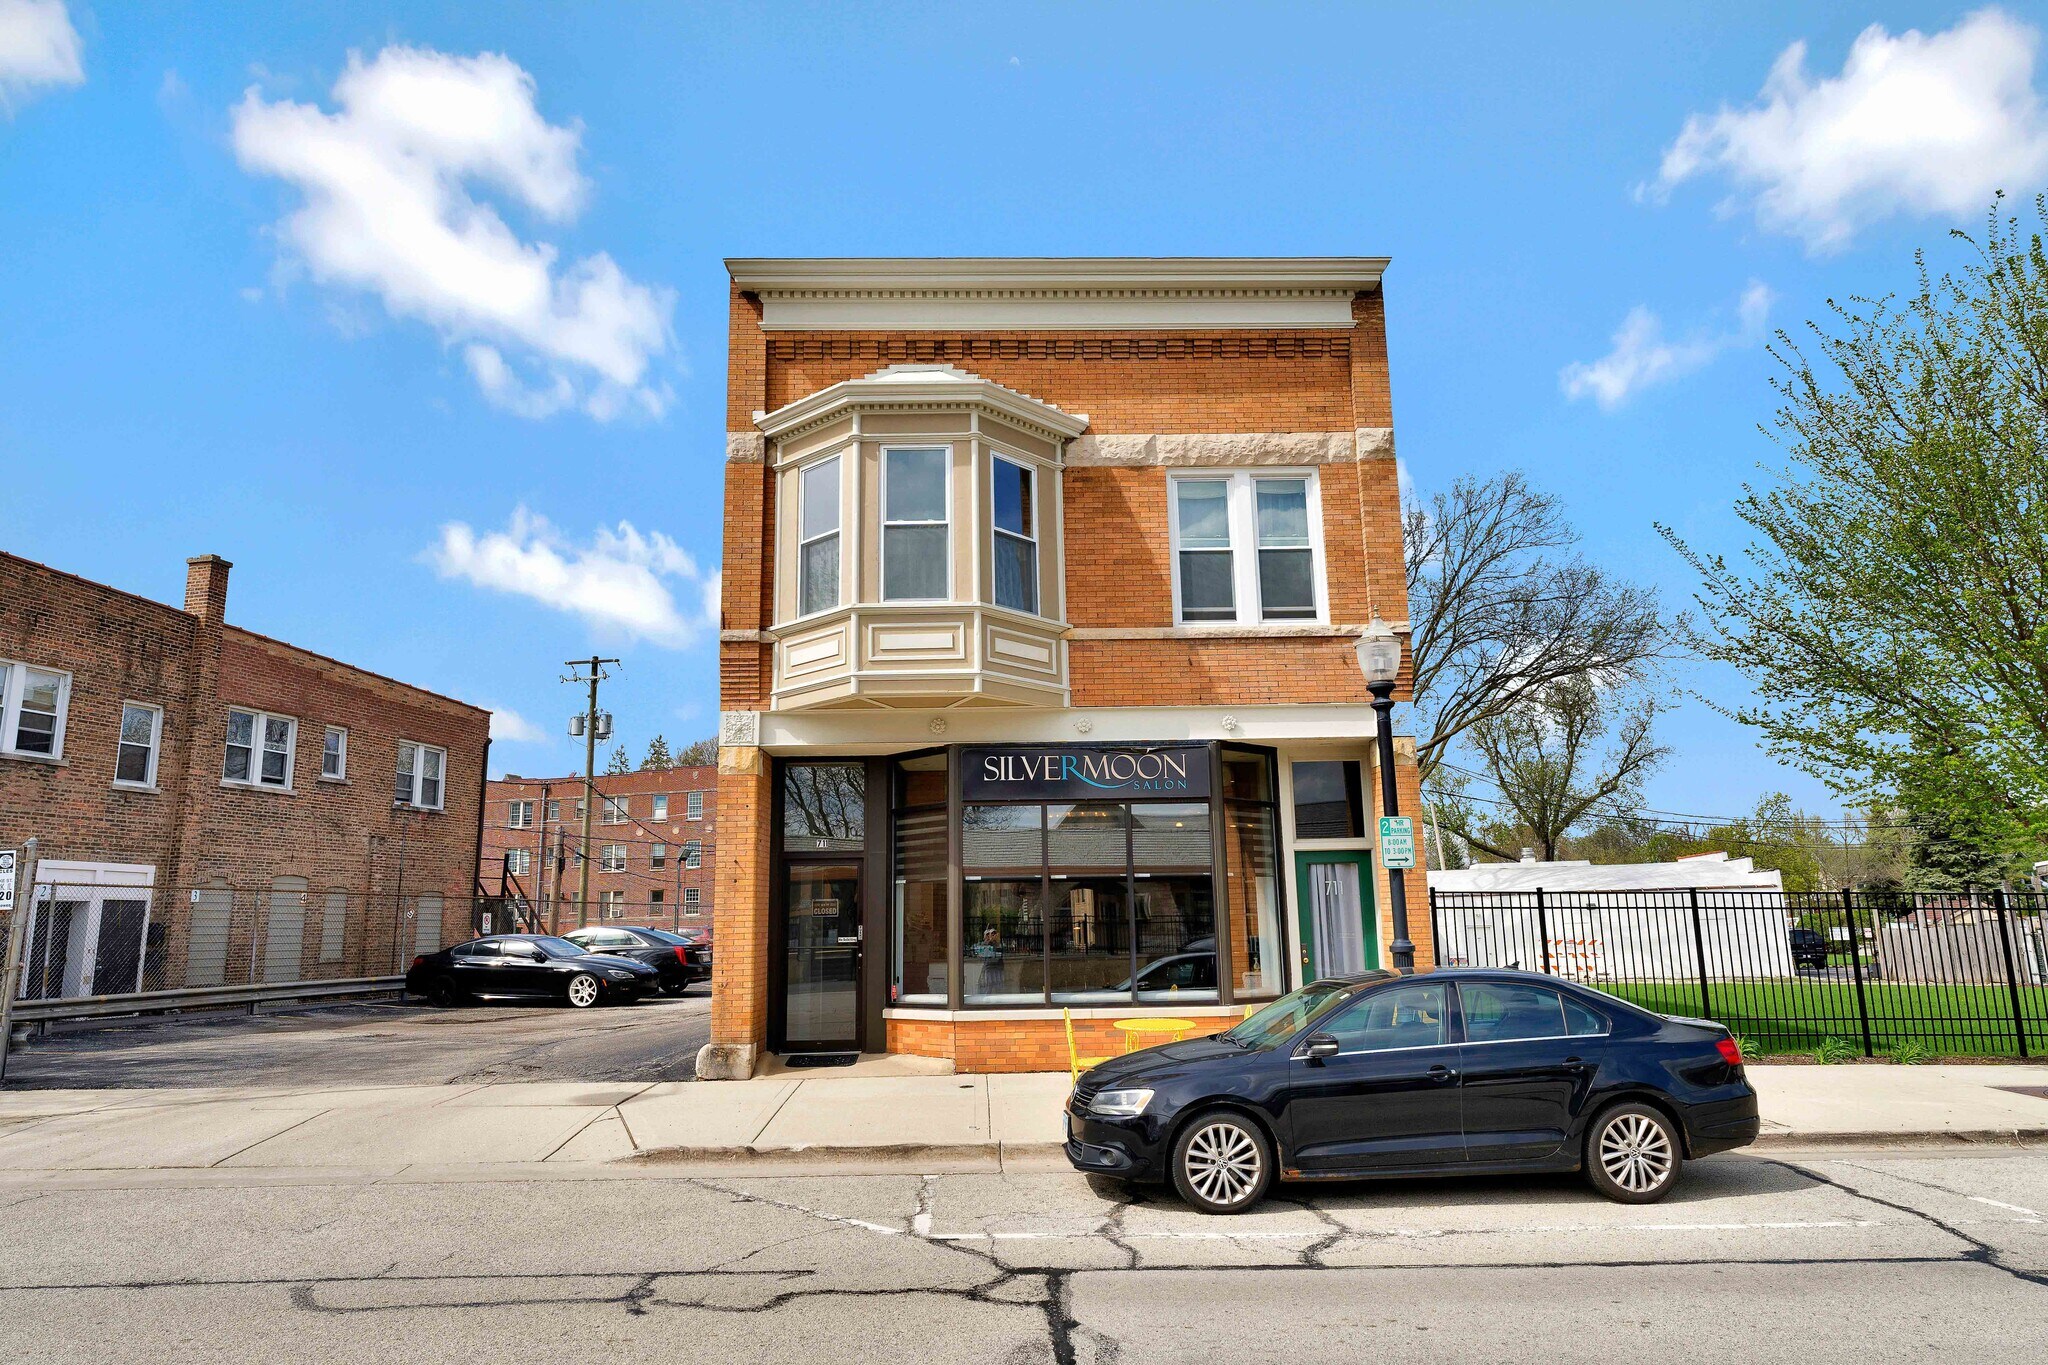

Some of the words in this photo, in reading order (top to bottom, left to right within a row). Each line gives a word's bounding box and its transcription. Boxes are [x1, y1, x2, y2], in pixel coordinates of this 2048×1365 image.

[984, 753, 1187, 787] SILVERMOON
[1133, 779, 1188, 790] SALON
[1382, 820, 1389, 834] 2
[41, 886, 47, 897] 2
[1325, 880, 1344, 896] 711
[193, 890, 198, 901] 3
[813, 907, 837, 915] CLOSED
